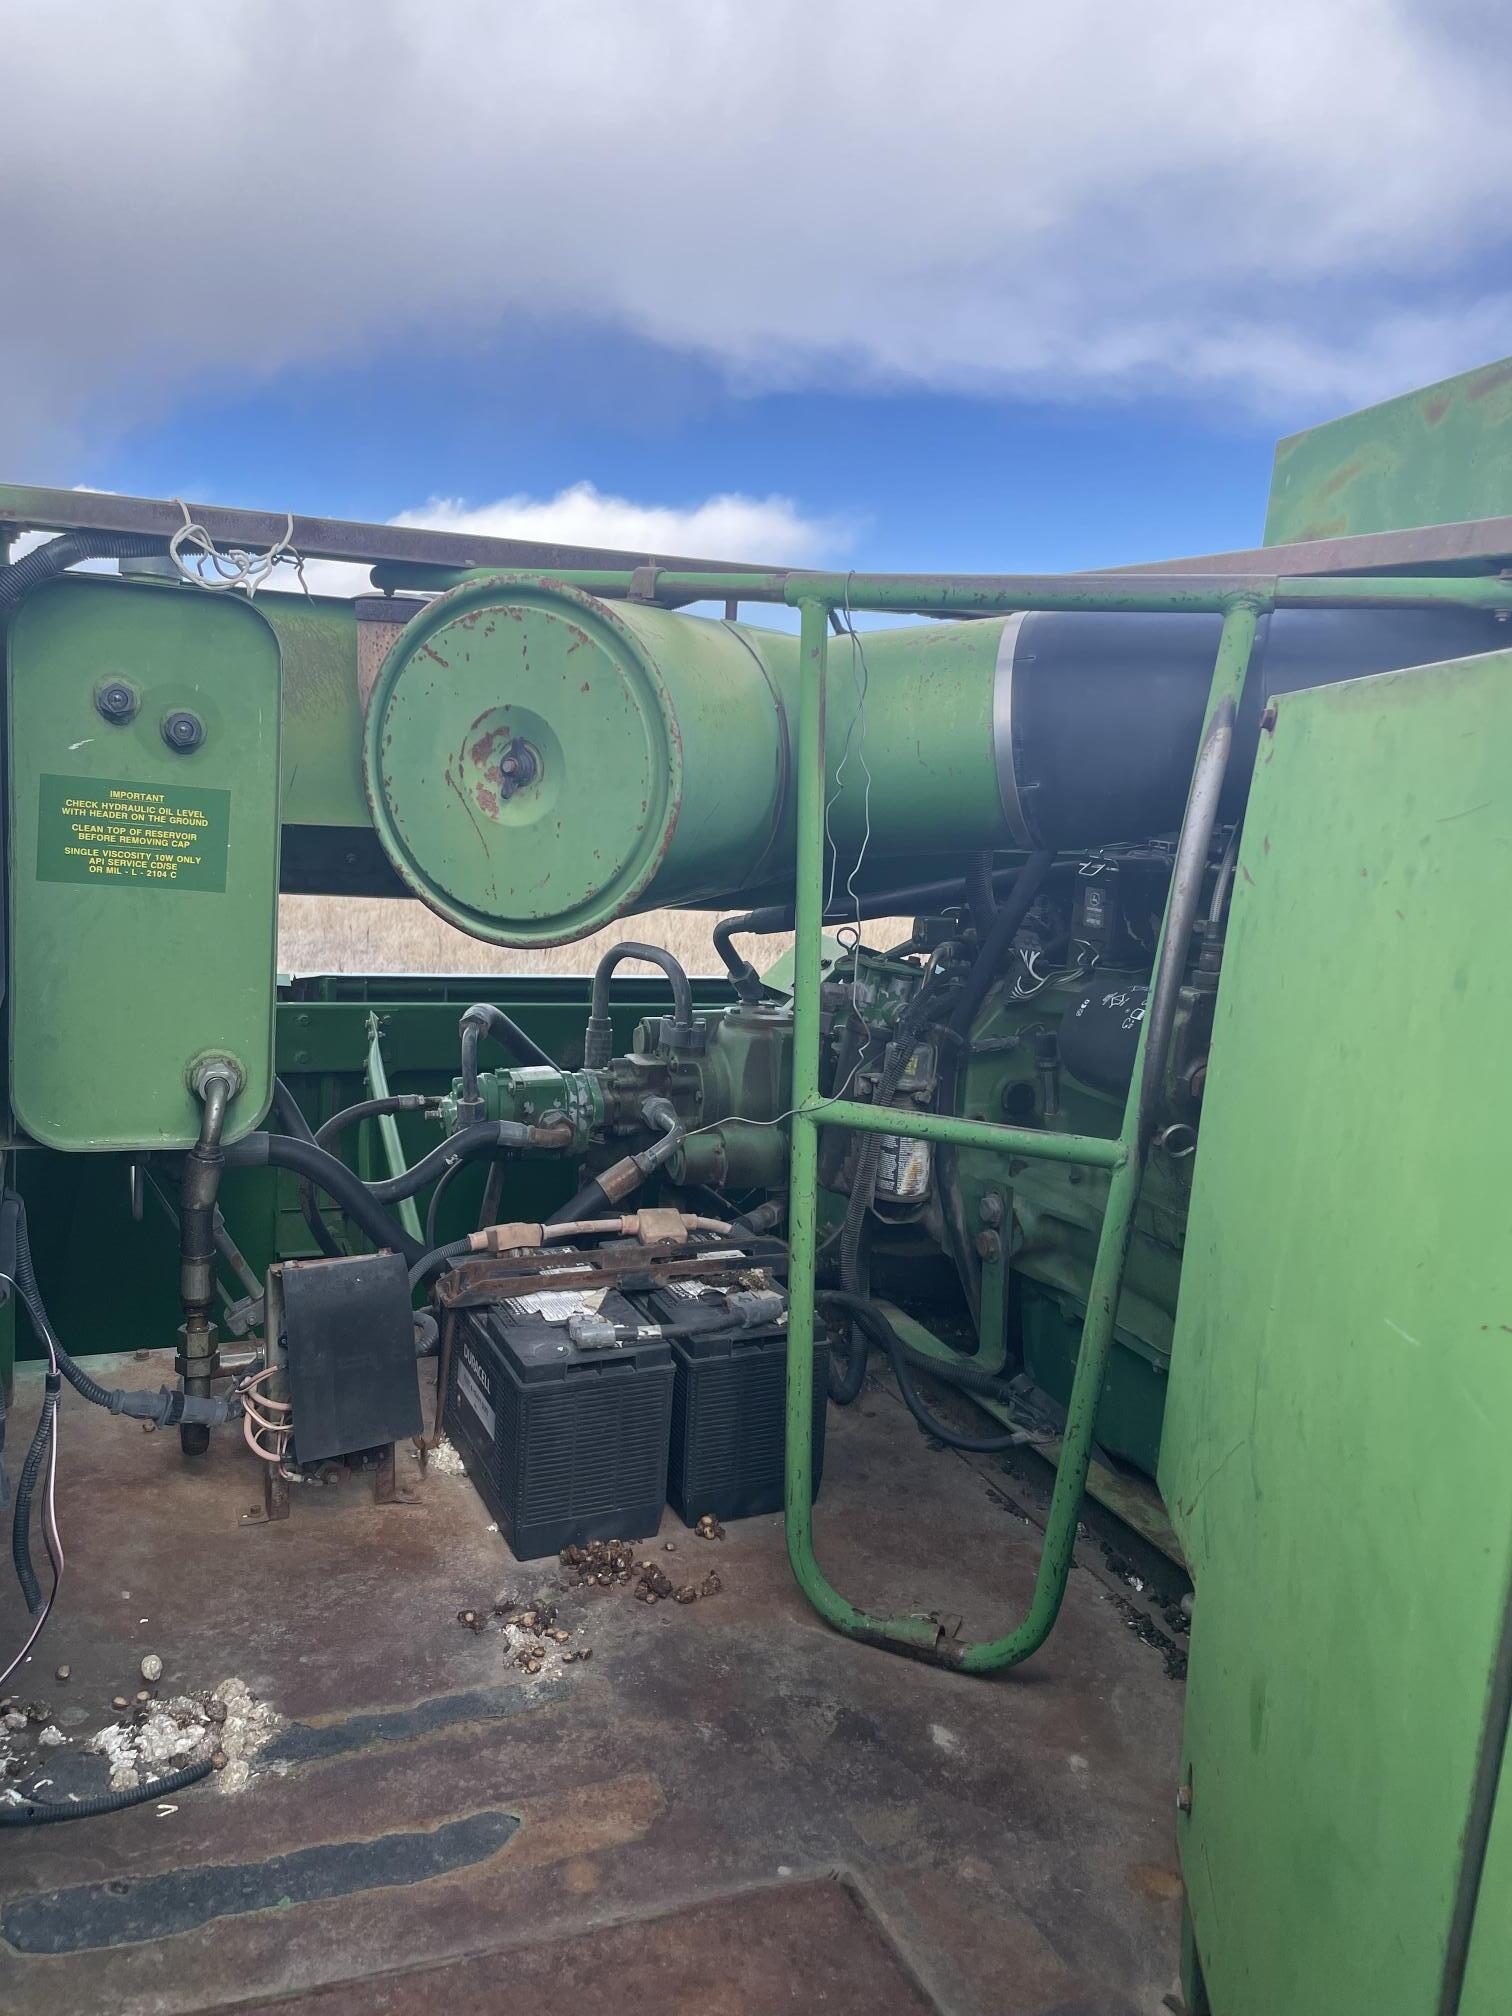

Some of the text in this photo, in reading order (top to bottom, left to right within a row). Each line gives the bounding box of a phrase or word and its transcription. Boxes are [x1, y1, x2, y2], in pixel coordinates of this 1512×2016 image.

[110, 790, 164, 802] IMPORTANT
[66, 800, 204, 818] CHECK HYDRAULIC OIL LEVEL
[62, 808, 86, 816] WITH
[90, 810, 127, 820] HEADER
[148, 815, 166, 823] THE
[170, 817, 208, 827] GROUND
[72, 824, 197, 840] CLEAN TOP OF RESERVOIR
[79, 833, 190, 848] BEFORE REMOVING CAP
[64, 847, 201, 864] SINGLE VISCOSITY 10W ONLY
[108, 859, 147, 868] SERVICE
[151, 861, 177, 870] CD/SE
[106, 867, 121, 875] MIL
[171, 871, 177, 879] C
[463, 1343, 491, 1395] DURACELL
